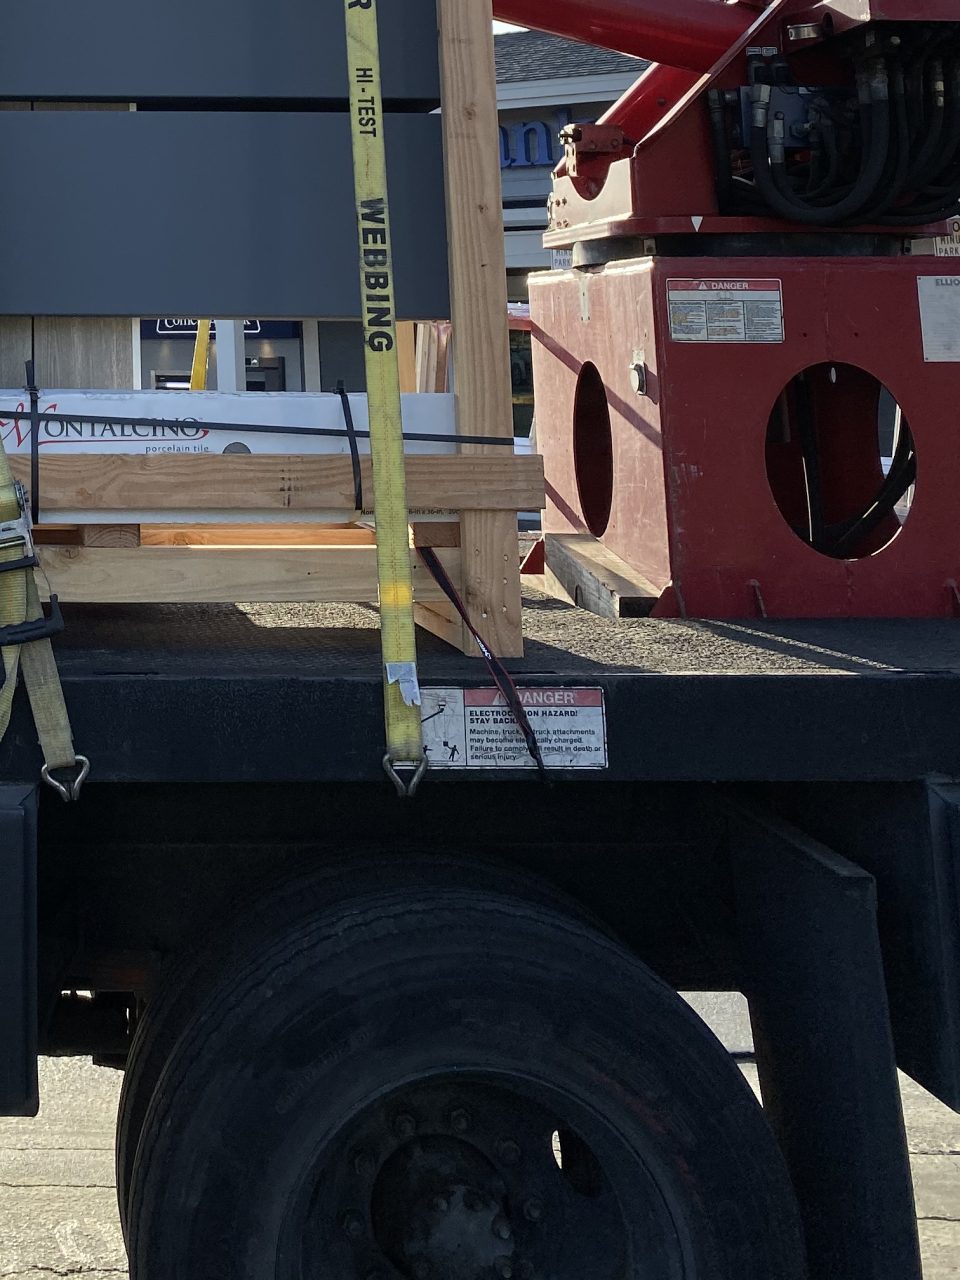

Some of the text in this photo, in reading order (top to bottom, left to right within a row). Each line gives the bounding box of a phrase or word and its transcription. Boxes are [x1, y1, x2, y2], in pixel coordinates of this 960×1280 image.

[360, 198, 394, 352] WEBBING
[145, 444, 209, 454] porcelain tile
